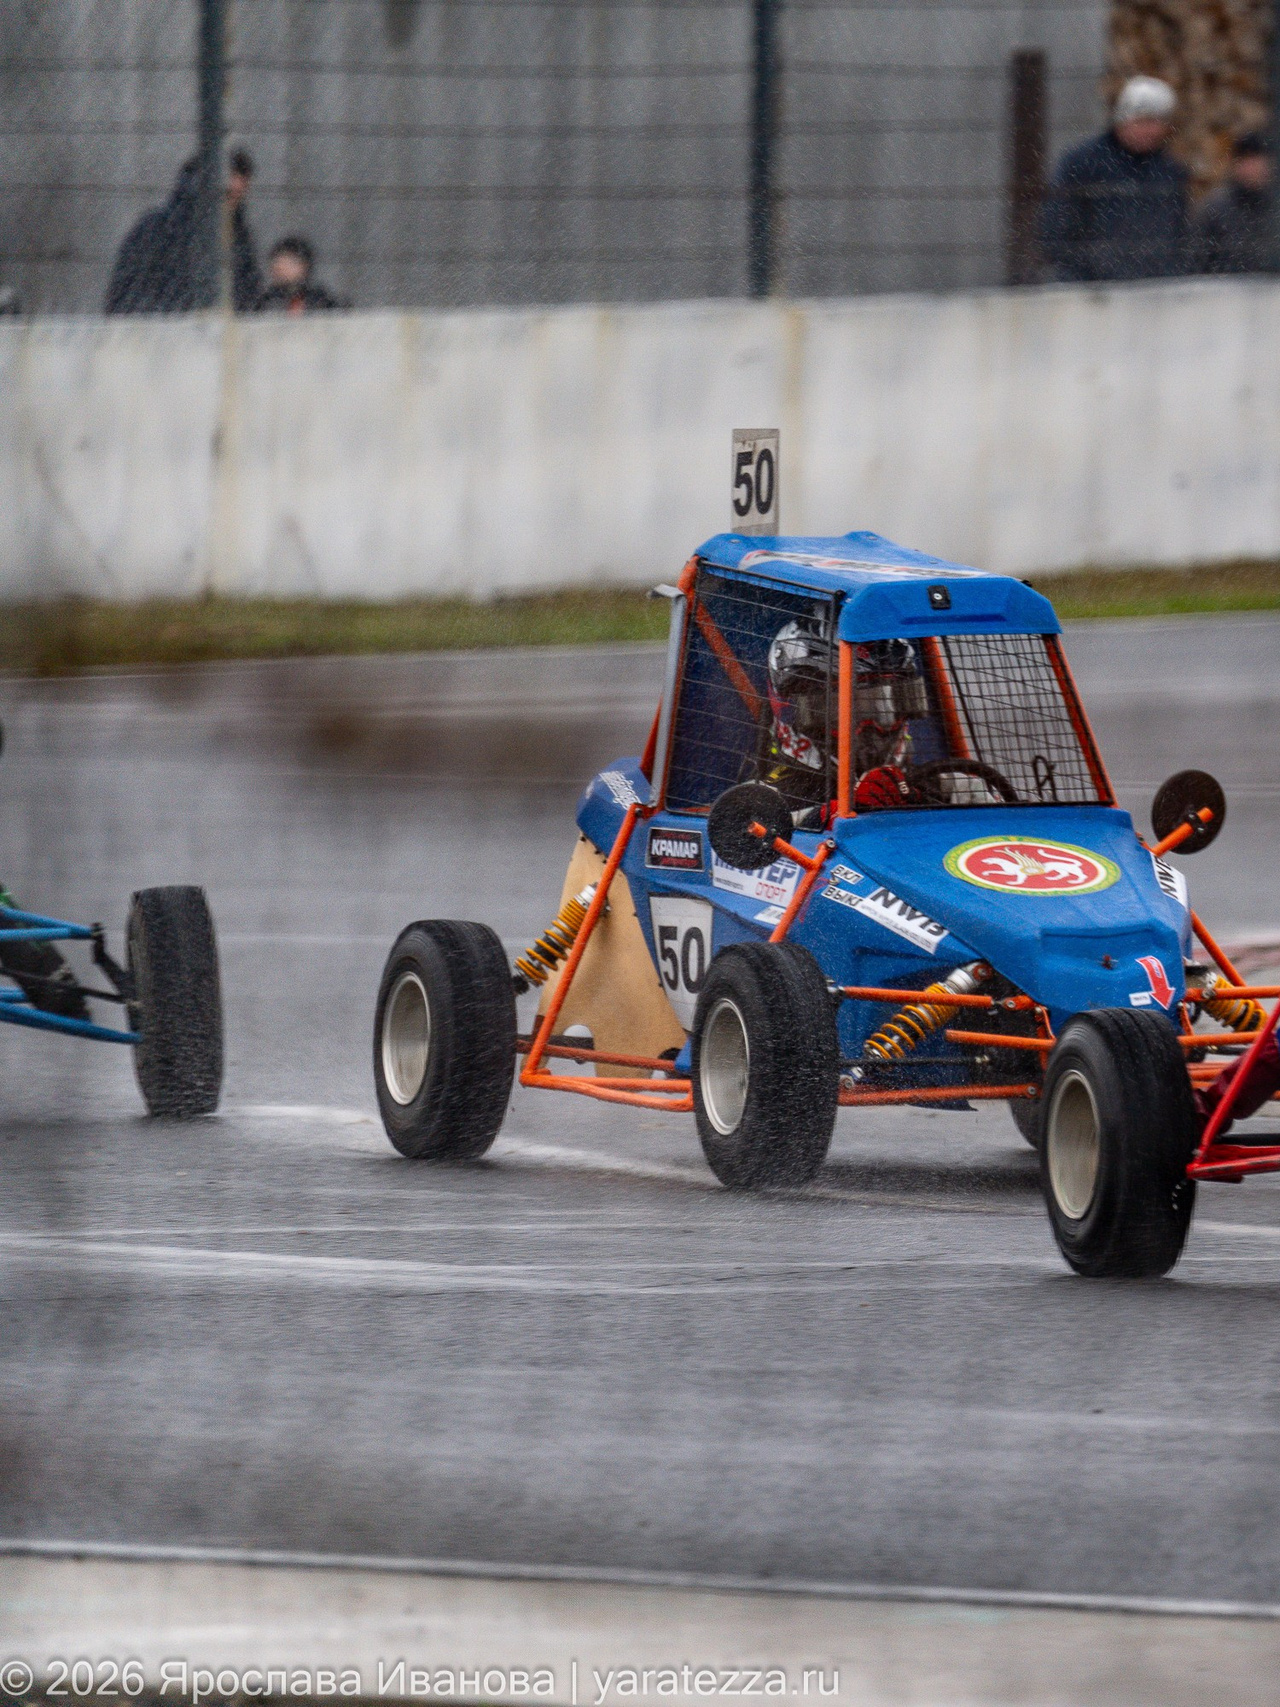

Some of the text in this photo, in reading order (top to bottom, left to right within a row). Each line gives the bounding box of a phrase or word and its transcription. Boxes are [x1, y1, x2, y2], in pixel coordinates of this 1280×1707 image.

[733, 448, 774, 517] 50
[651, 838, 699, 859] КРАМАР
[833, 865, 861, 883] ВКЛ
[658, 925, 705, 994] 50
